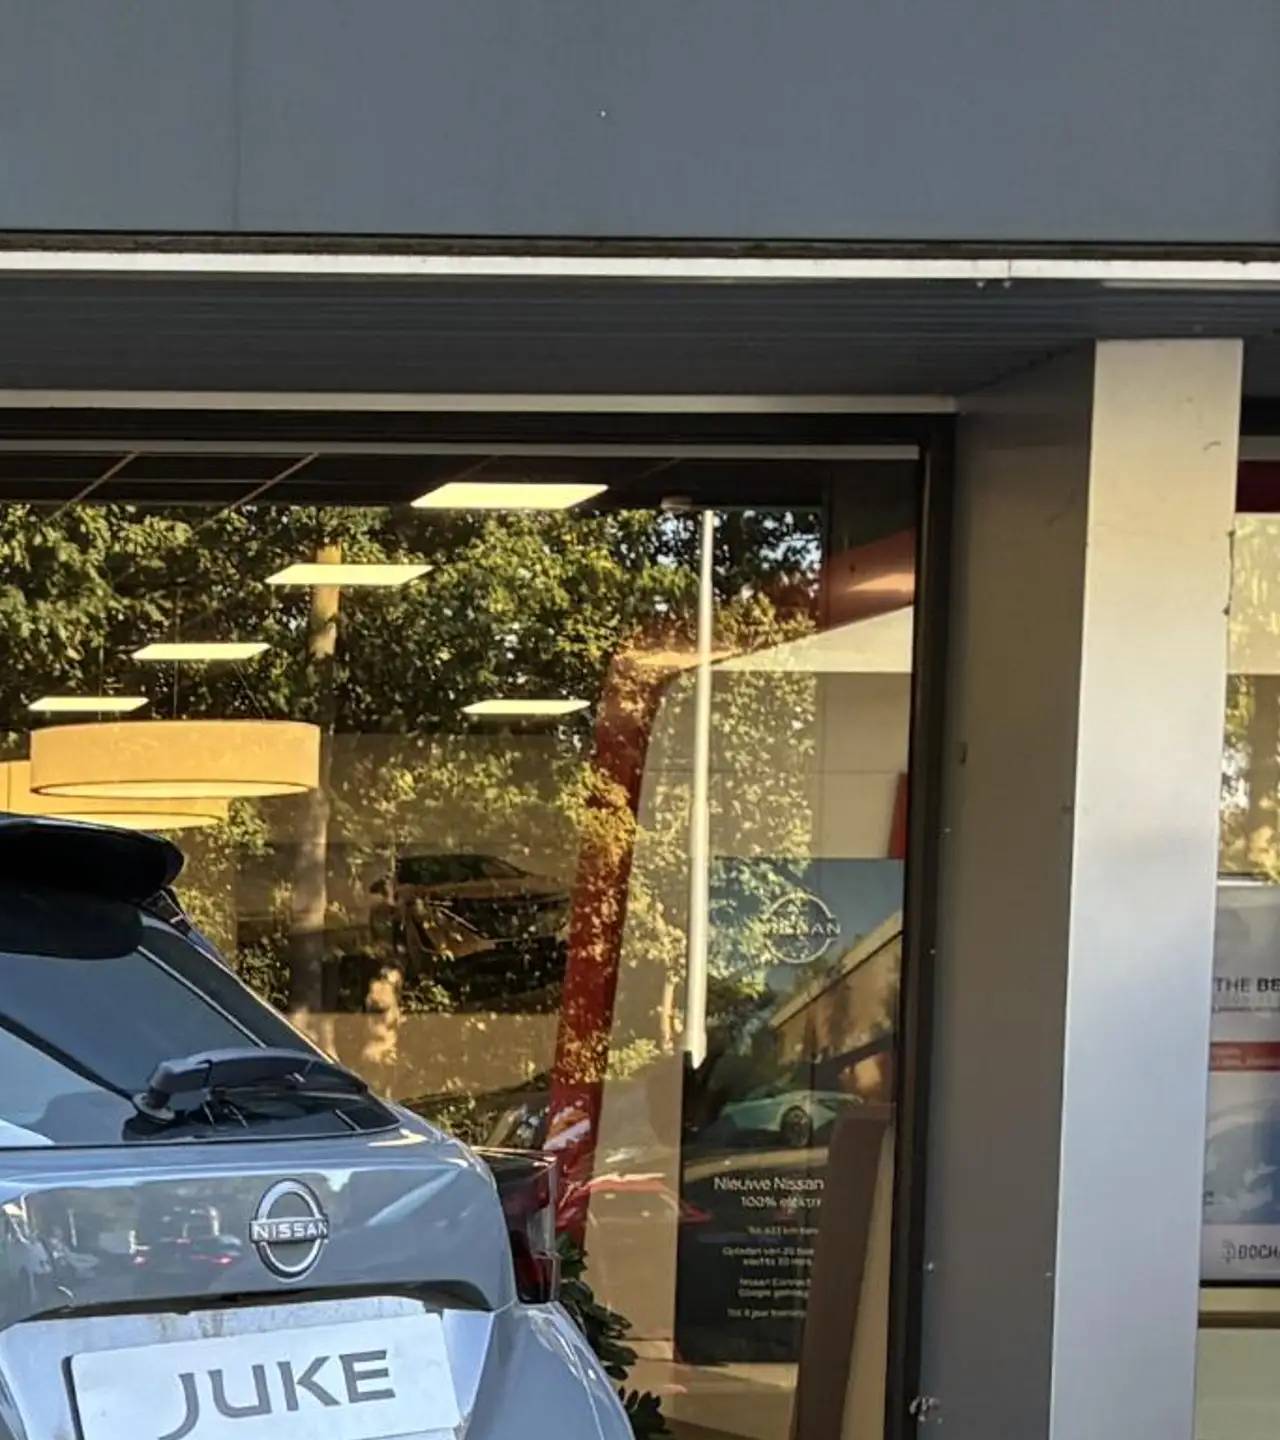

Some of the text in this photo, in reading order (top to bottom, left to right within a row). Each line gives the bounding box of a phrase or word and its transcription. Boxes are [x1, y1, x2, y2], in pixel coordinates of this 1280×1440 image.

[1214, 977, 1252, 993] THE
[713, 1176, 825, 1191] Nieuwe Nissan
[253, 1220, 328, 1240] NISSAN
[1239, 1244, 1280, 1260] BOCH
